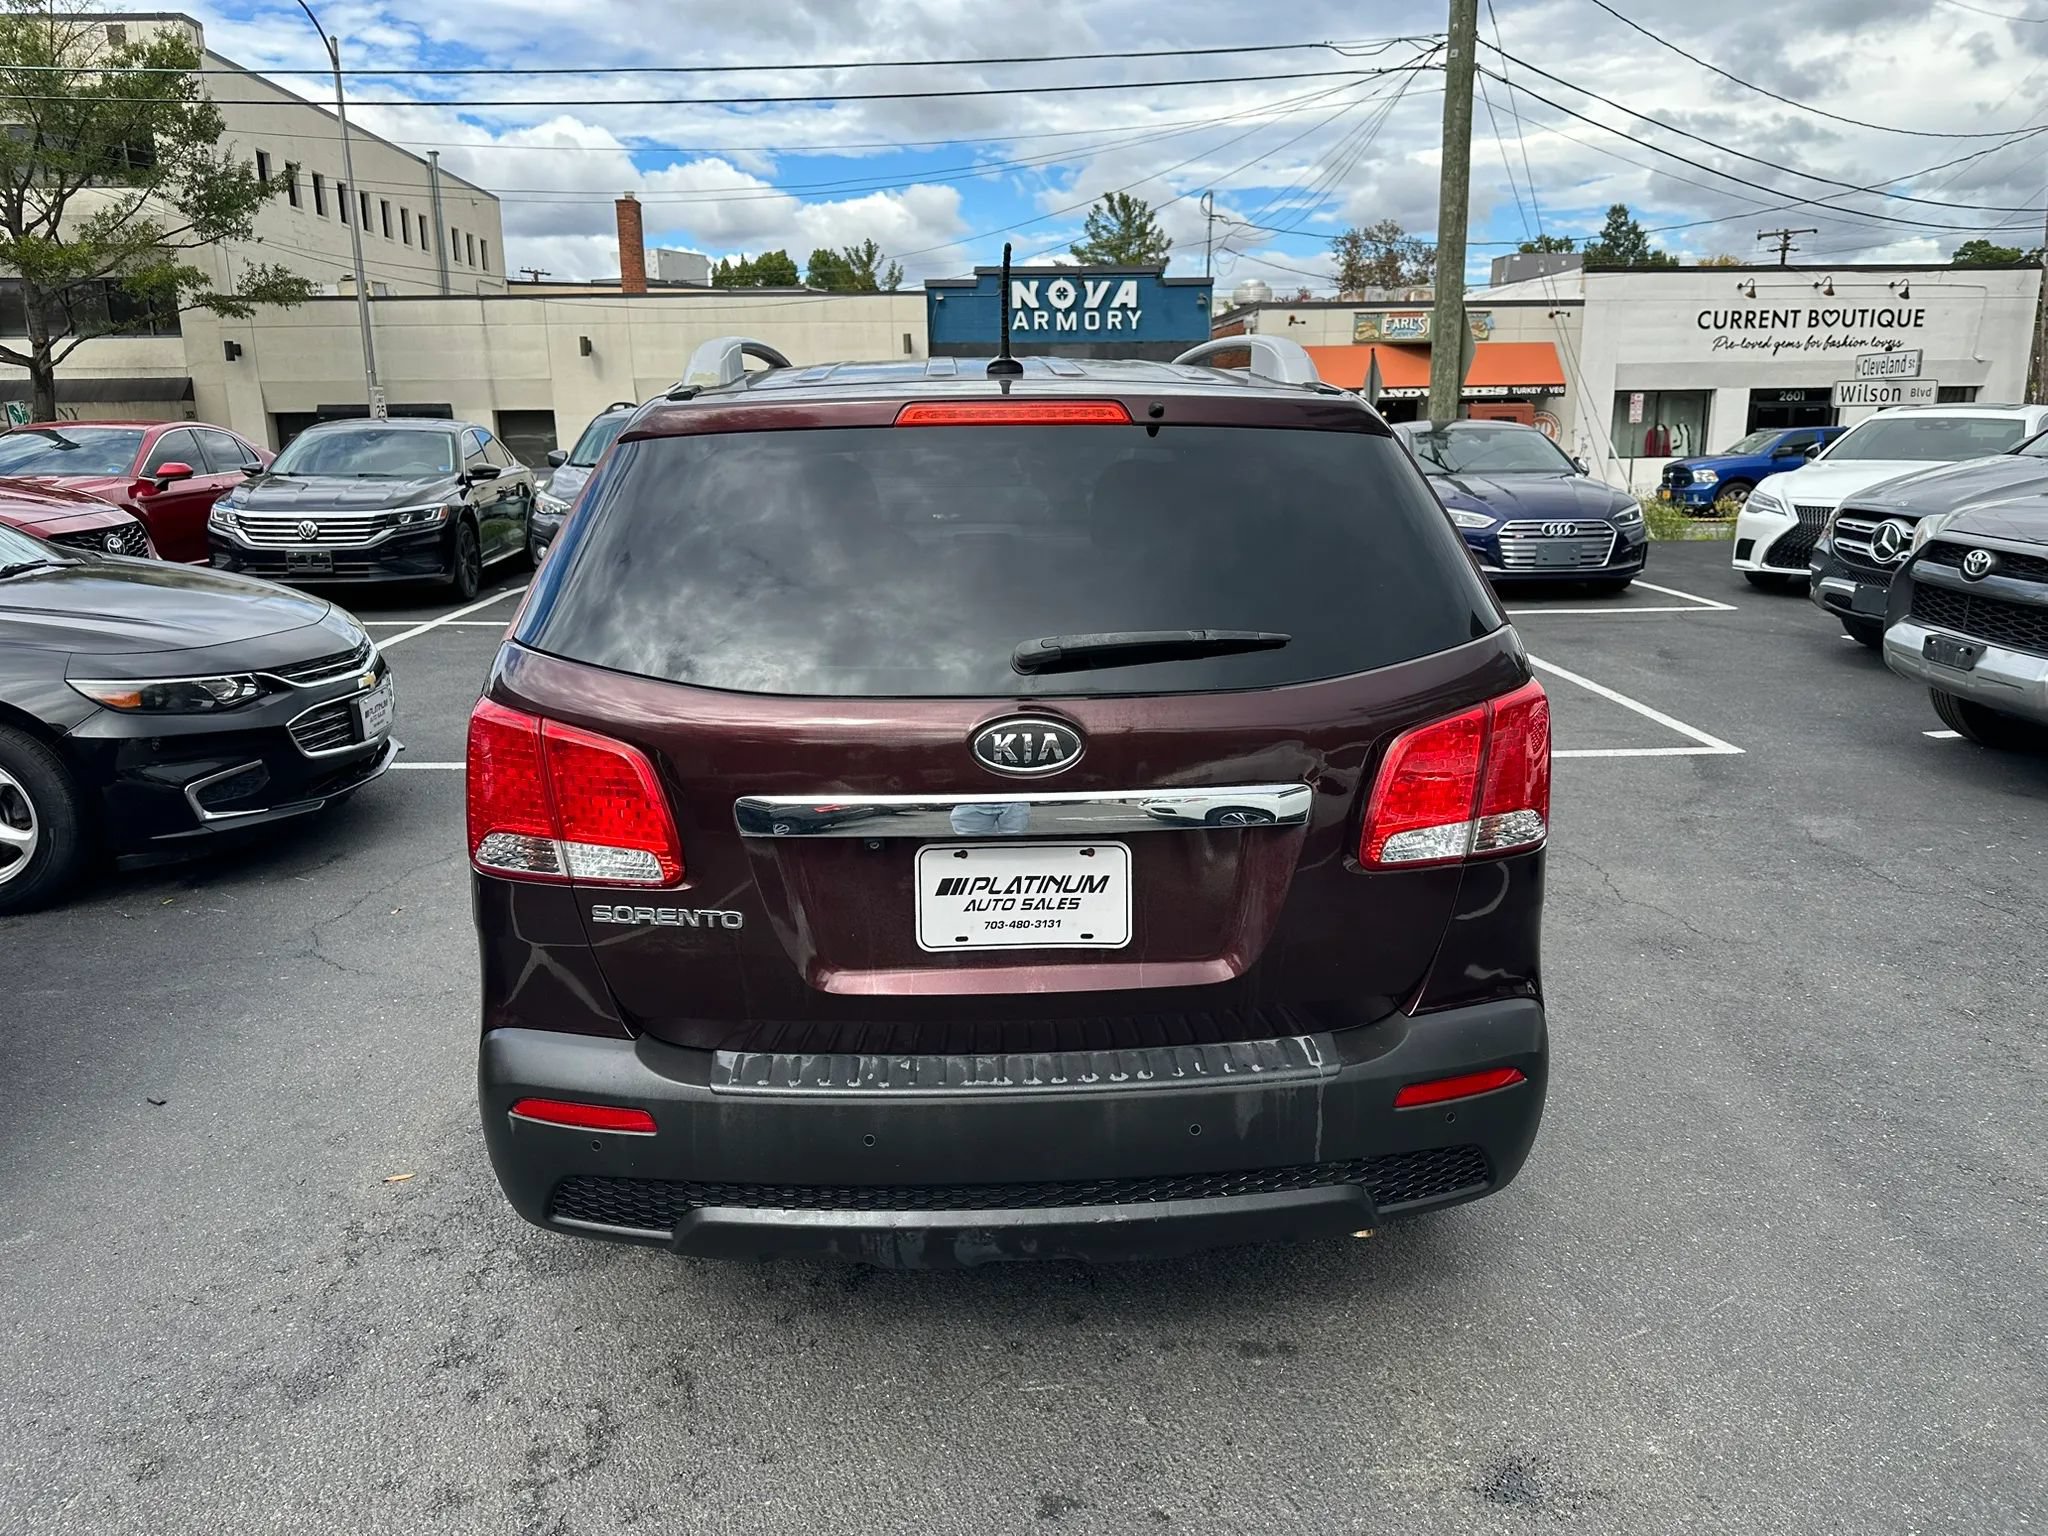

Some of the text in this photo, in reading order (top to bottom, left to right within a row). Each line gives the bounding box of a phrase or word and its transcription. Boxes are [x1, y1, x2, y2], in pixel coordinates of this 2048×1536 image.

[1011, 278, 1137, 311] NOVA
[1012, 310, 1142, 331] ARMORY
[1697, 308, 1925, 329] CURRENT BOUTIQUE
[1712, 334, 1904, 356] Pre-loved gems for fashion lovers
[1862, 354, 1907, 376] Cleveland
[1908, 359, 1915, 368] St
[1512, 386, 1541, 395] TURKEY
[1549, 386, 1565, 394] VEG
[1780, 390, 1805, 402] 2601
[1841, 384, 1932, 402] Wilson Blvd
[376, 404, 386, 418] 25
[992, 732, 1065, 763] KIA
[968, 875, 1110, 896] PLATINUM
[963, 897, 1082, 912] AUTO SALES
[591, 904, 743, 930] SORENTO
[984, 919, 1062, 931] 703-480-3131
